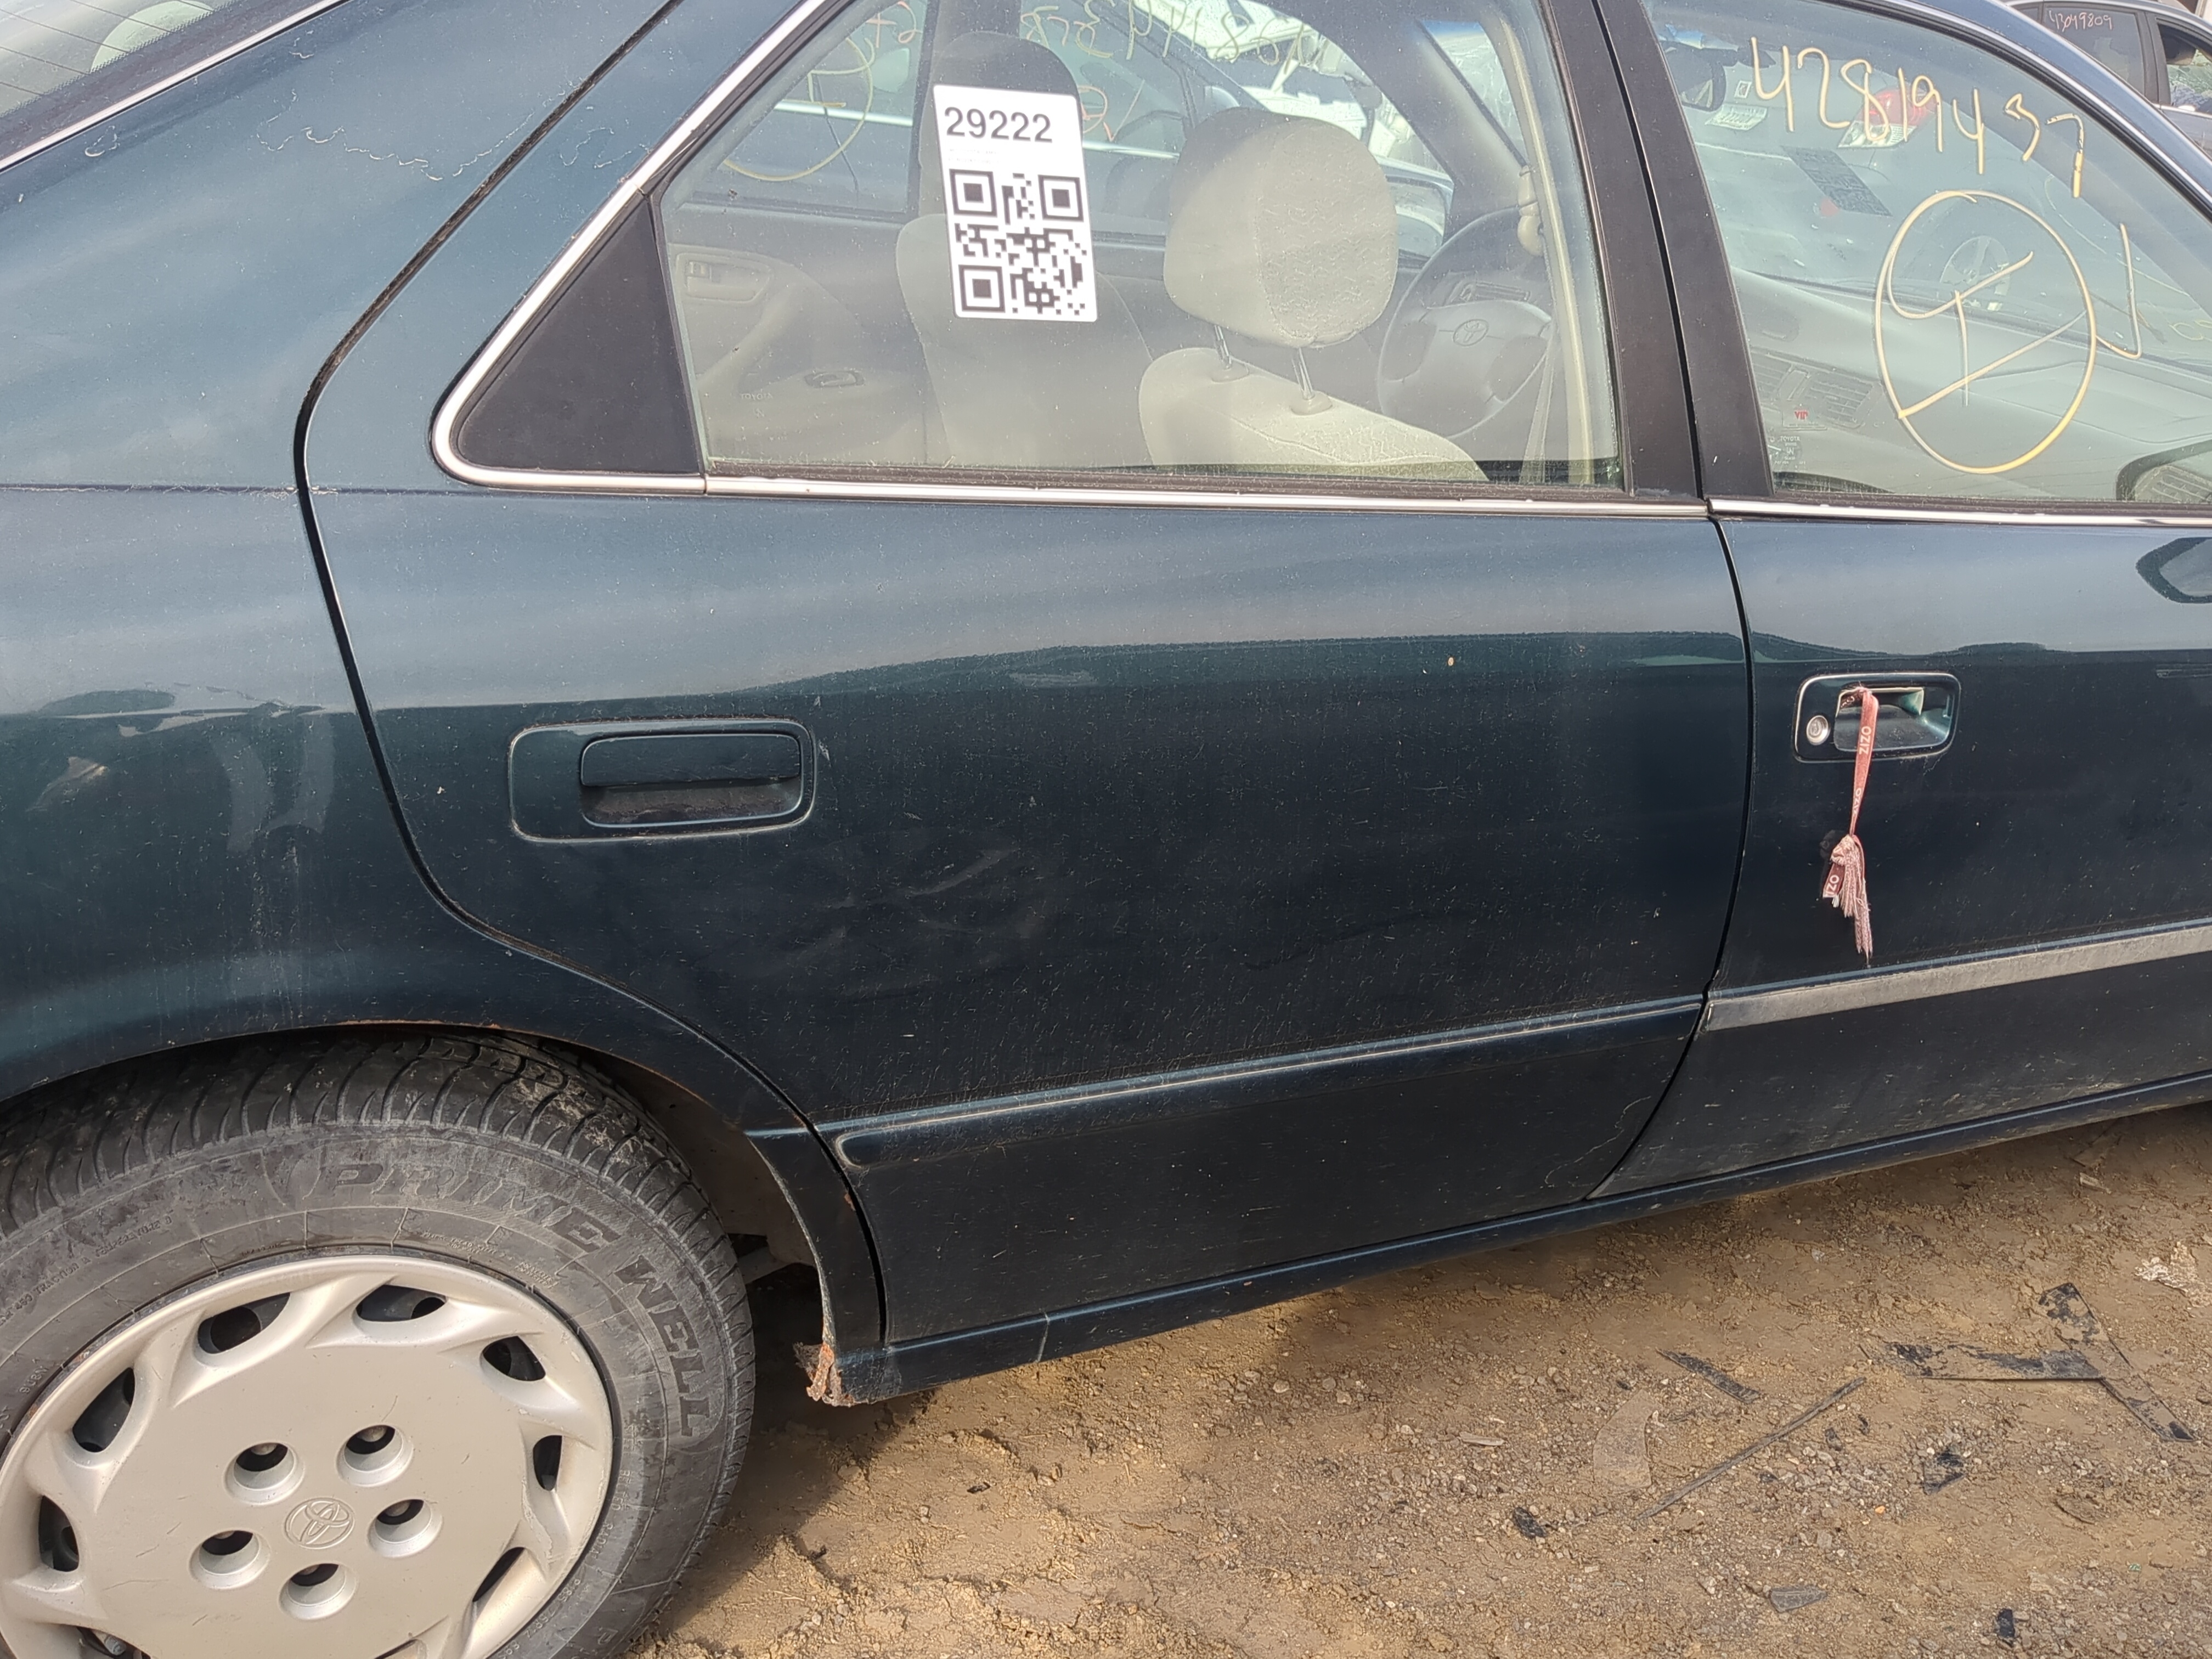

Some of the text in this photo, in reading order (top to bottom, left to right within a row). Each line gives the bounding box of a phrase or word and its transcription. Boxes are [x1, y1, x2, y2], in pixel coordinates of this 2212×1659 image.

[2049, 10, 2112, 32] 43049809
[944, 106, 1053, 144] 29222
[1750, 36, 2084, 199] 42819437
